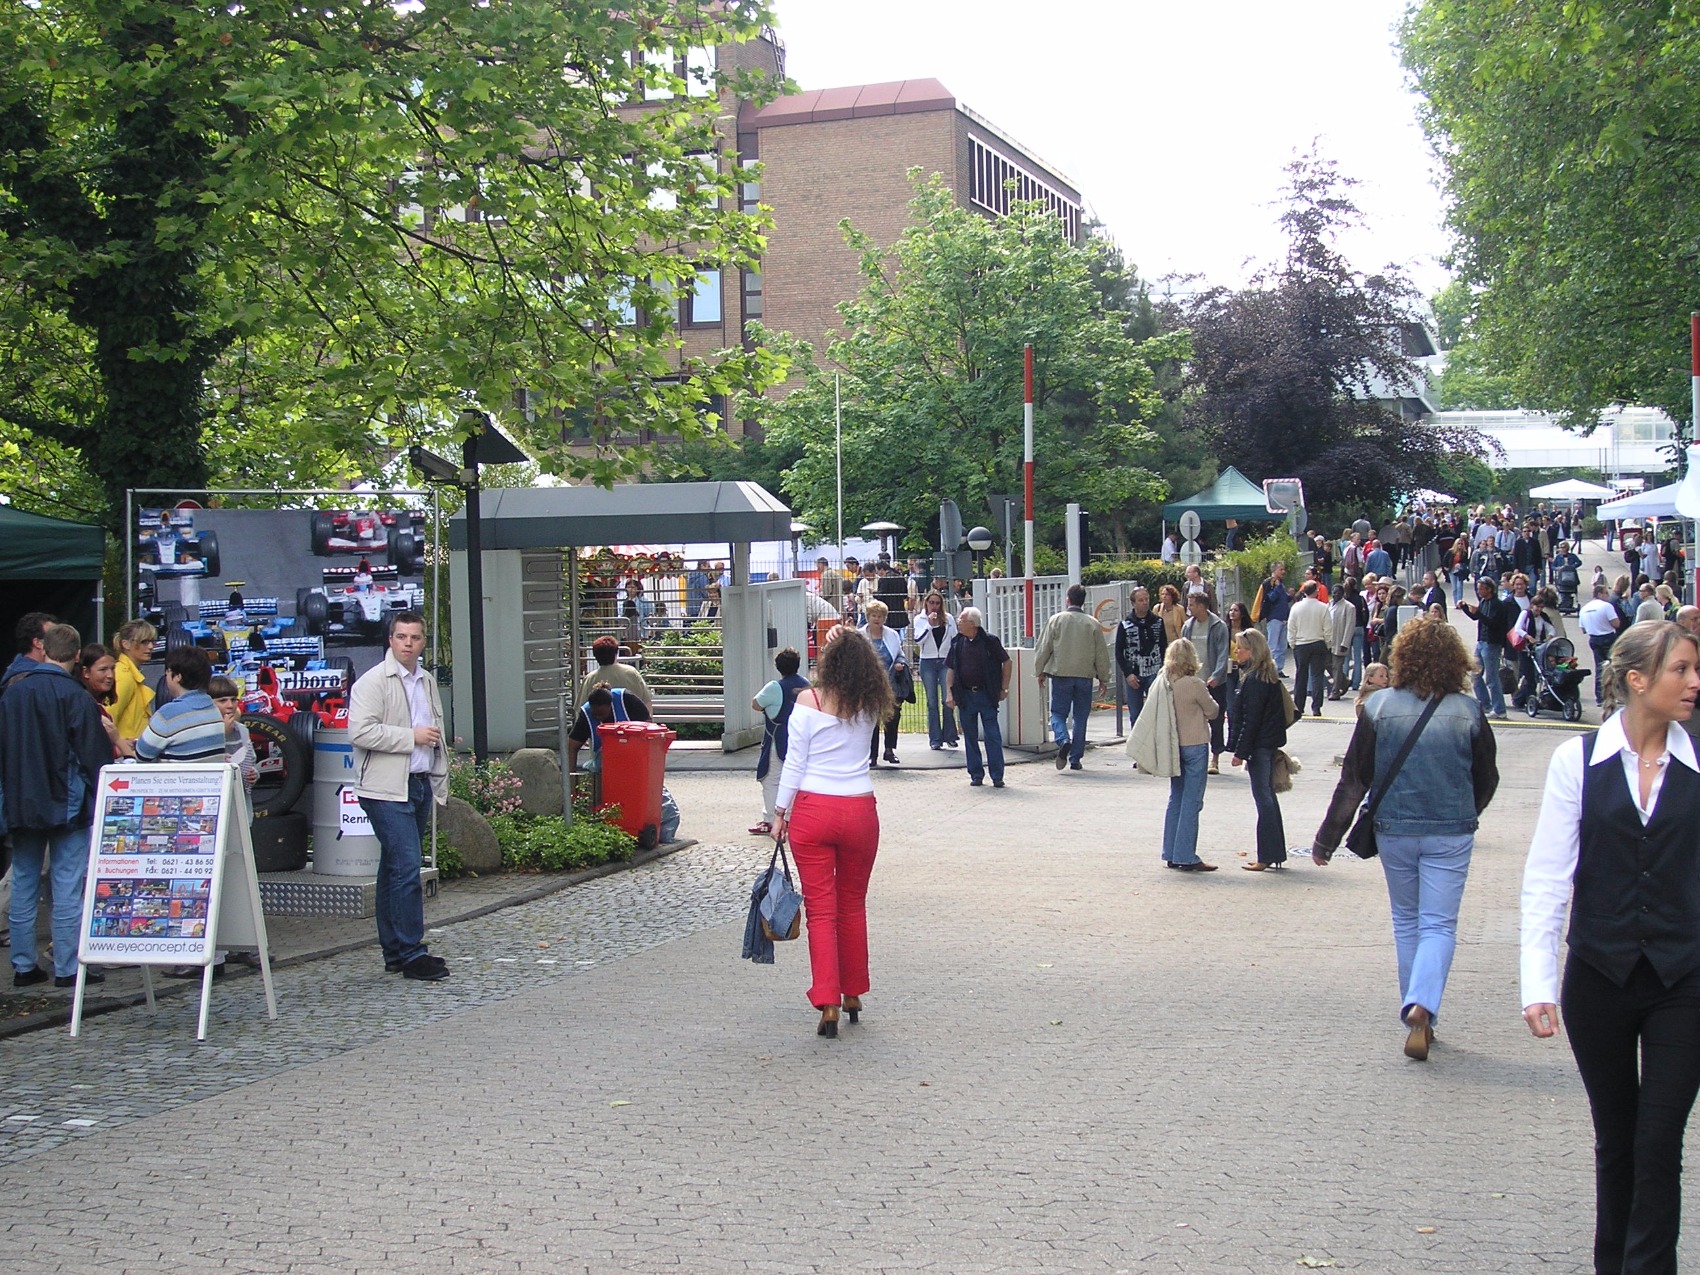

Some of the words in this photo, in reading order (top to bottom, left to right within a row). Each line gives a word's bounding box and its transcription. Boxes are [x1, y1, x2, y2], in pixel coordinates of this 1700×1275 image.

[131, 776, 152, 785] Planen
[152, 776, 161, 785] Sie
[178, 776, 223, 786] Veranstaltung?
[342, 814, 370, 824] Renn
[88, 942, 204, 954] www.eyeconcept.de
